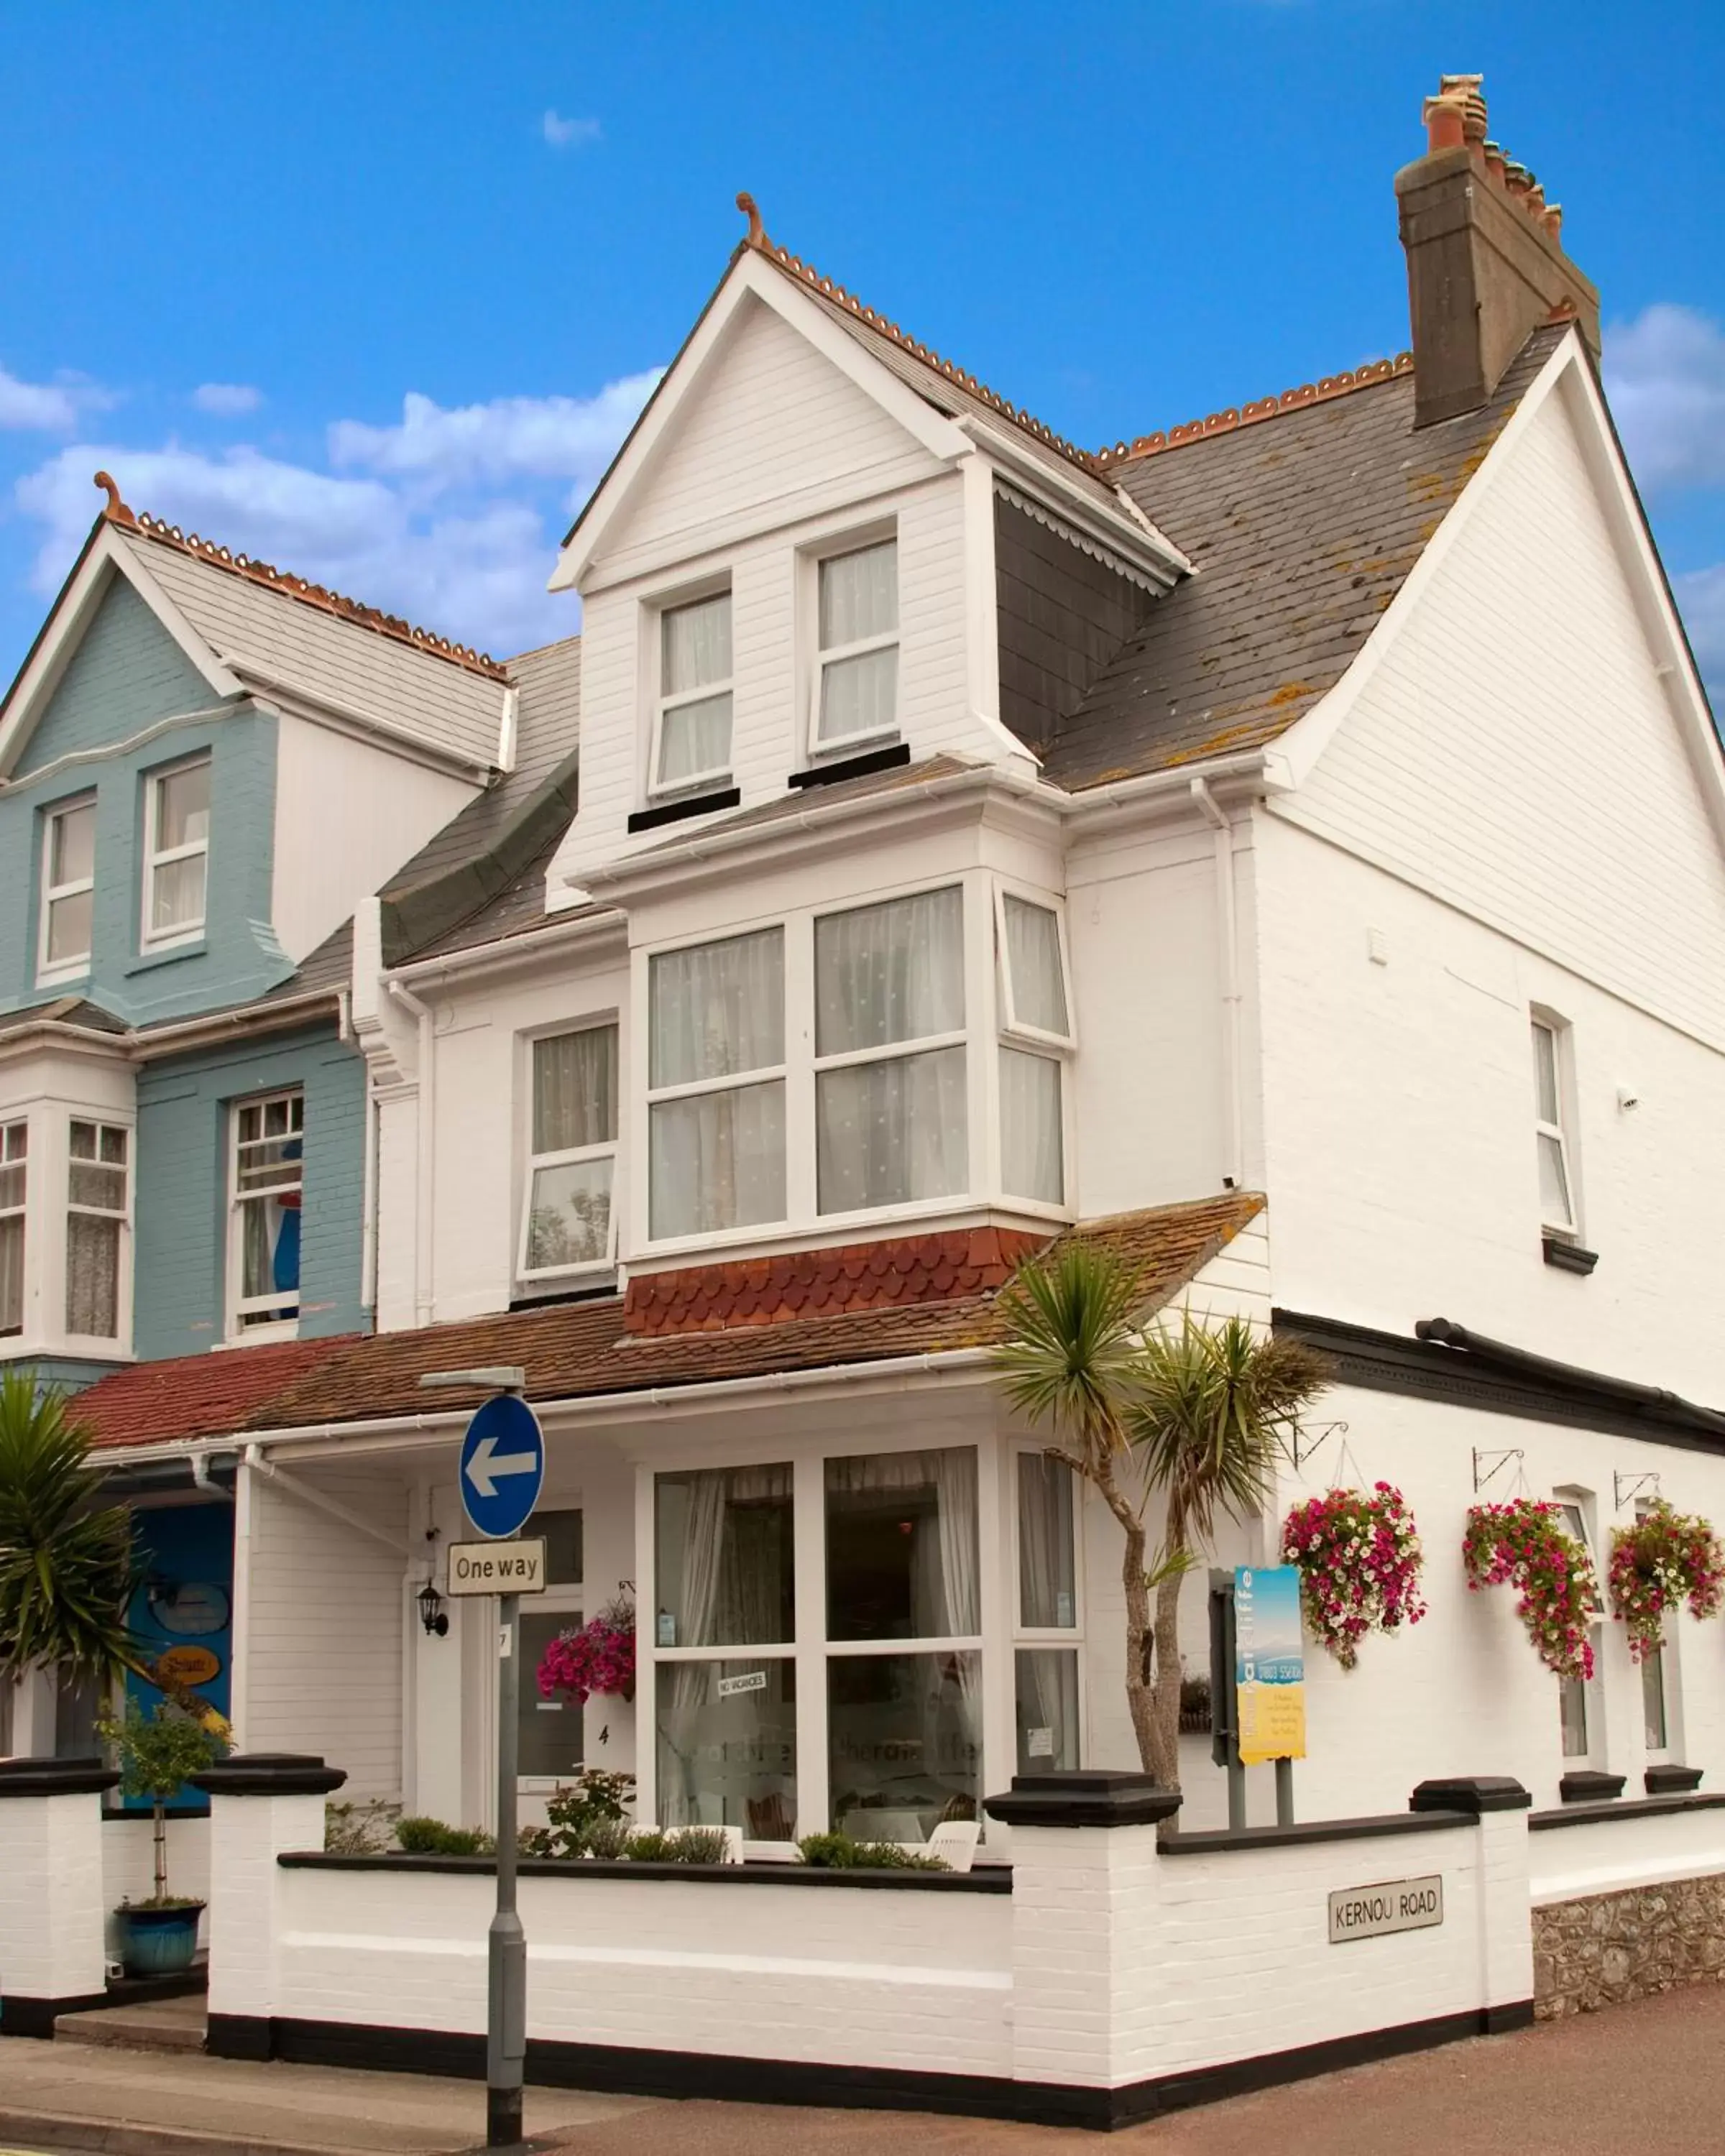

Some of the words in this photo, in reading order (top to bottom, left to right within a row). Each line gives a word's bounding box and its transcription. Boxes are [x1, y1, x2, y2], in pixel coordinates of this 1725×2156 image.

[456, 1557, 494, 1579] One
[497, 1558, 538, 1580] way
[599, 1724, 610, 1746] 4
[1335, 1897, 1393, 1928] KERNOU
[1399, 1889, 1437, 1917] ROAD
